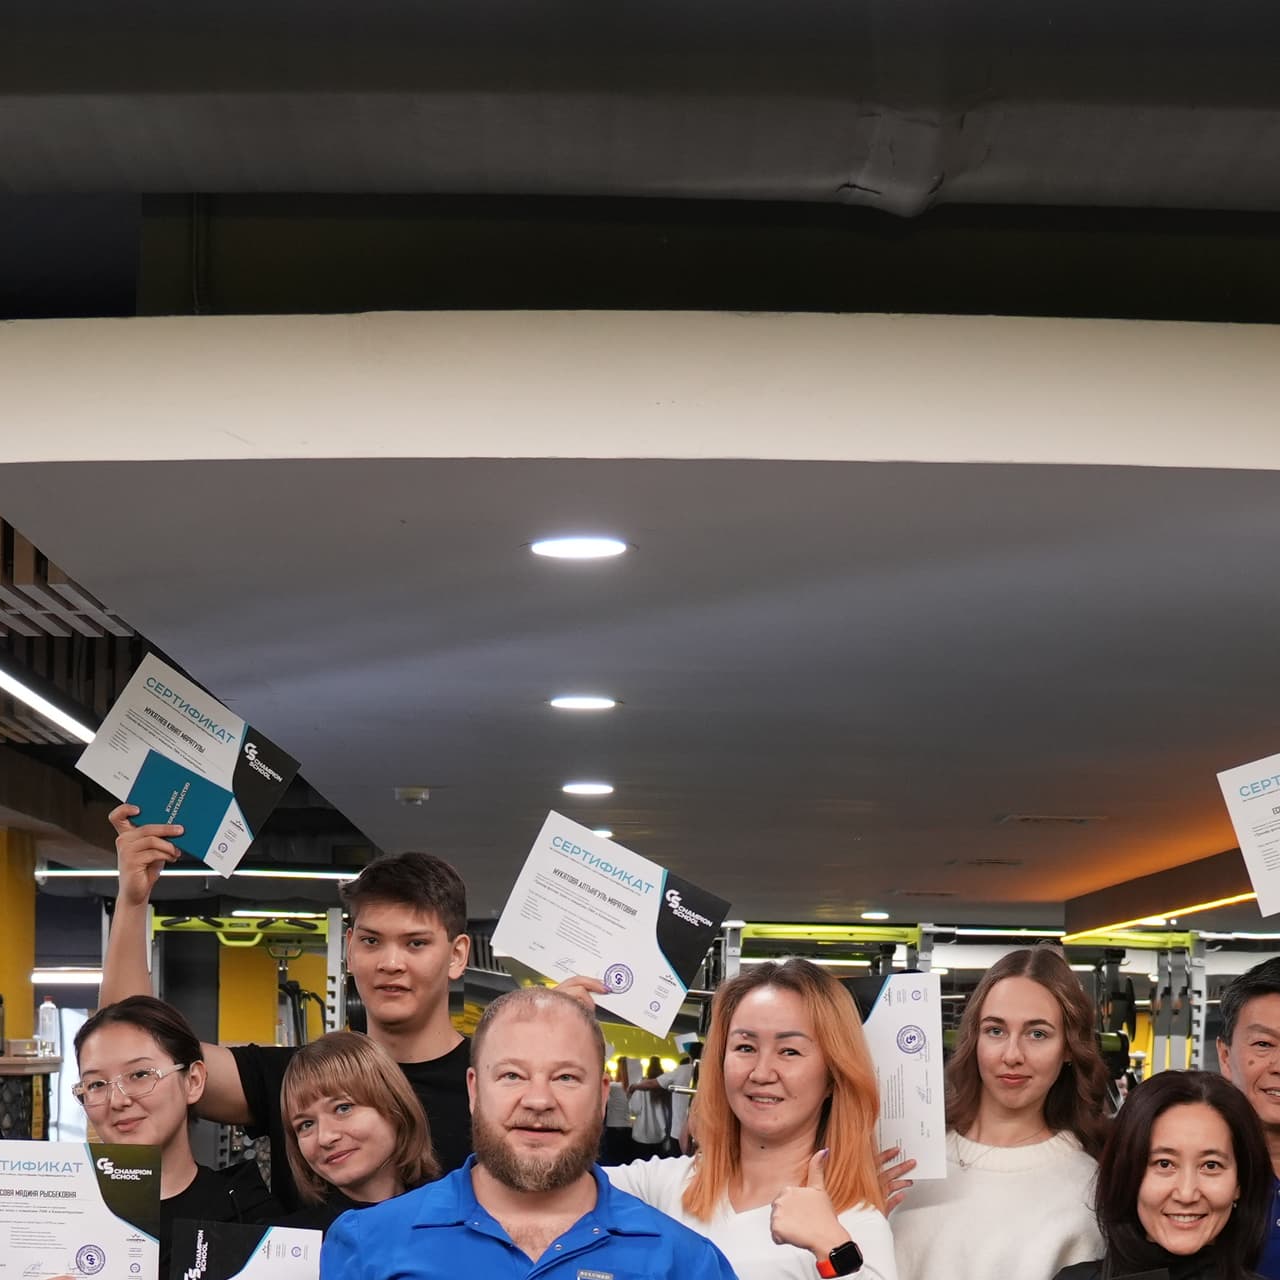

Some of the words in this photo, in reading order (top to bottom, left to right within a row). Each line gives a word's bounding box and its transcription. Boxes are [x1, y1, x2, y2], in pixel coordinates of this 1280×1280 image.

[146, 677, 233, 741] СЕРТИФИКАТ
[248, 760, 270, 780] SCHOOL
[252, 757, 282, 781] CHAMPION
[552, 836, 653, 892] СЕРТИФИКАТ
[671, 907, 701, 928] SCHOOL
[676, 903, 714, 928] CHAMPION
[109, 1172, 141, 1181] SCHOOL
[112, 1167, 153, 1176] CHAMPION
[14, 1189, 38, 1197] МАДИНА
[39, 1190, 76, 1198] РЫСБЕКОВНА
[194, 1228, 204, 1269] CHAMPION
[199, 1240, 209, 1272] SCHOOL
